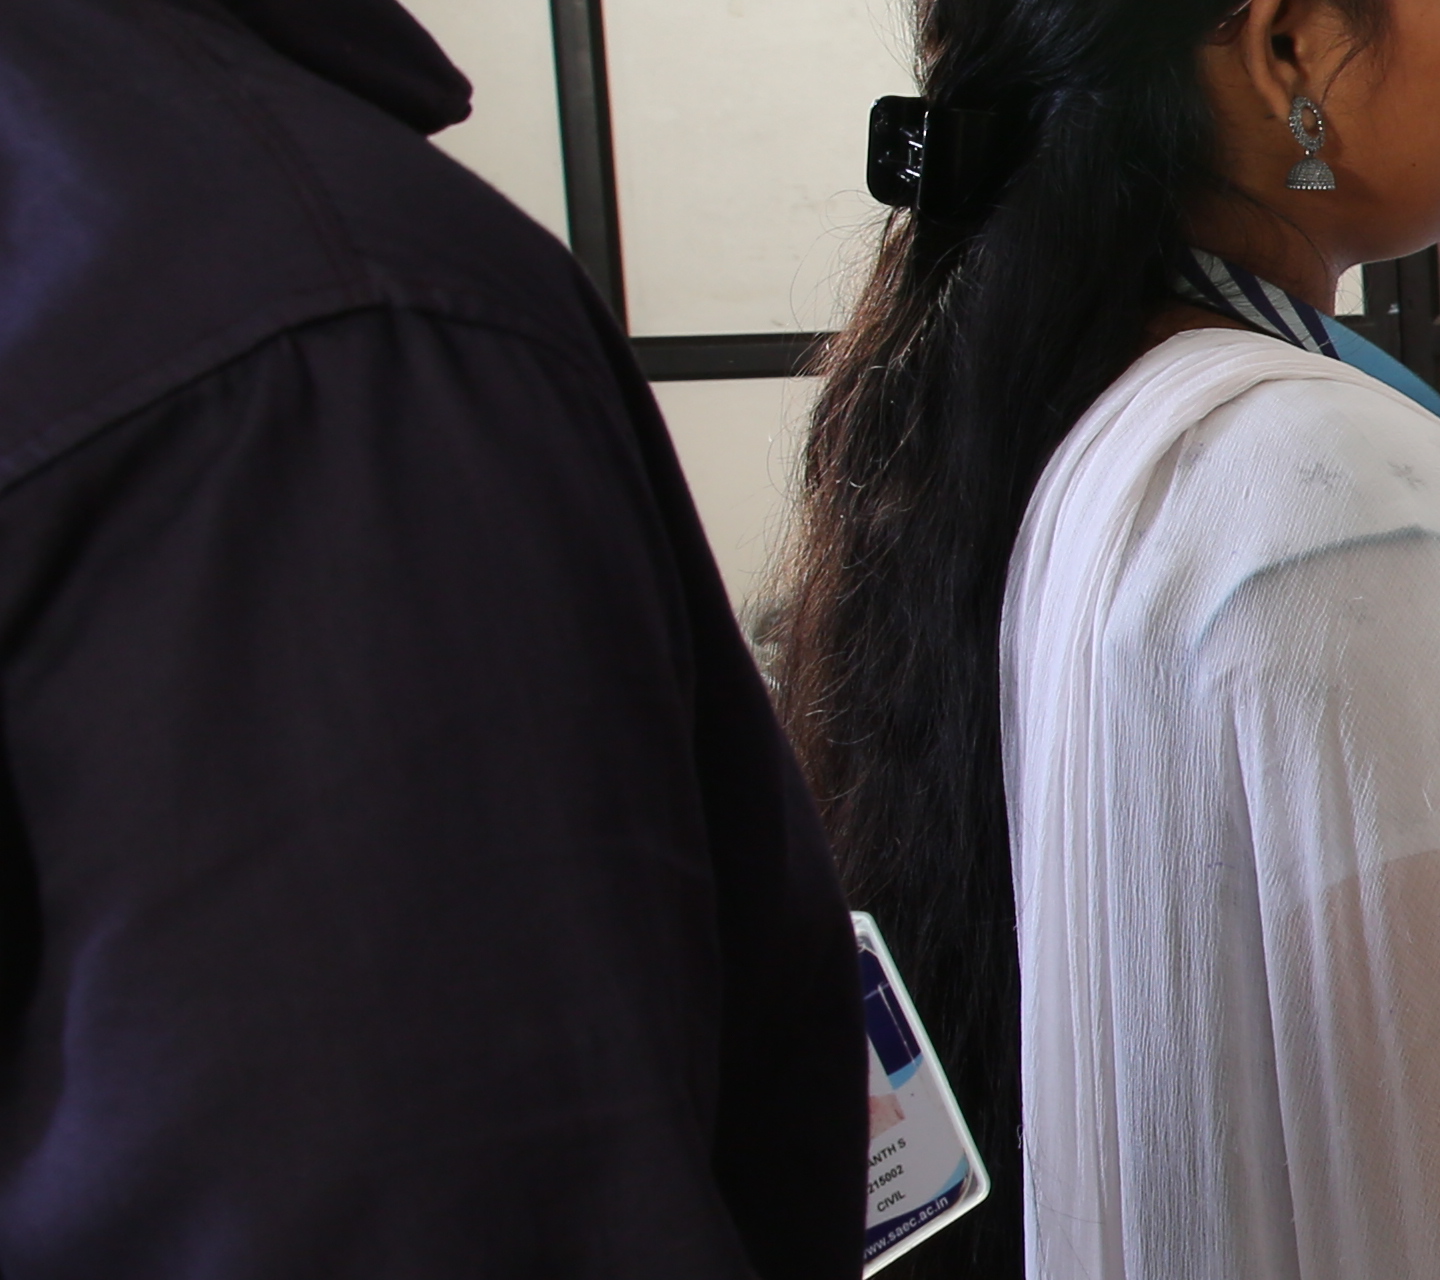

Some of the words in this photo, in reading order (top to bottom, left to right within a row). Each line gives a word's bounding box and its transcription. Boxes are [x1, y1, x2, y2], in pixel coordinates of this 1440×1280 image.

[867, 1143, 897, 1167] ANTH
[897, 1138, 906, 1149] S
[867, 1165, 904, 1194] 215002
[877, 1190, 906, 1212] CIVIL
[863, 1196, 949, 1259] ww.saec.ac.in
